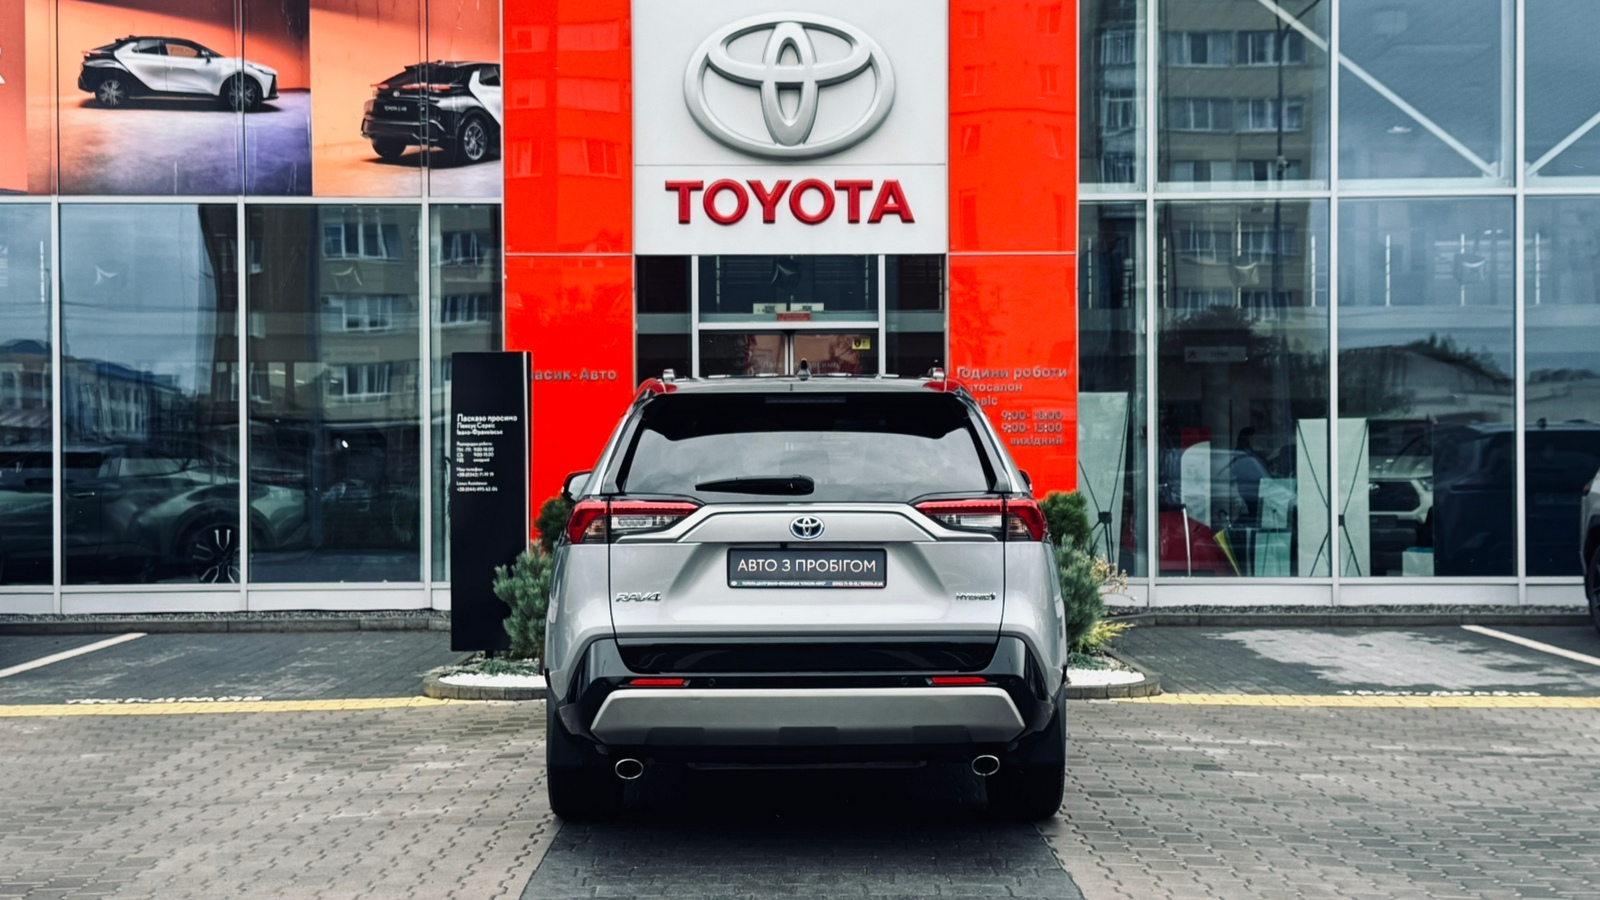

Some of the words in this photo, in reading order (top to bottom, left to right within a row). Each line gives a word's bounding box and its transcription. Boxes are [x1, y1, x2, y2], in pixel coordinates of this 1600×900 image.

[665, 178, 915, 225] TOYOTA
[957, 366, 1009, 380] Години
[1013, 365, 1067, 380] роботи
[487, 415, 518, 423] просимо
[737, 559, 778, 572] АВТО
[781, 559, 791, 572] З
[795, 559, 876, 573] ПРОБІГОМ
[616, 591, 662, 602] RAV4
